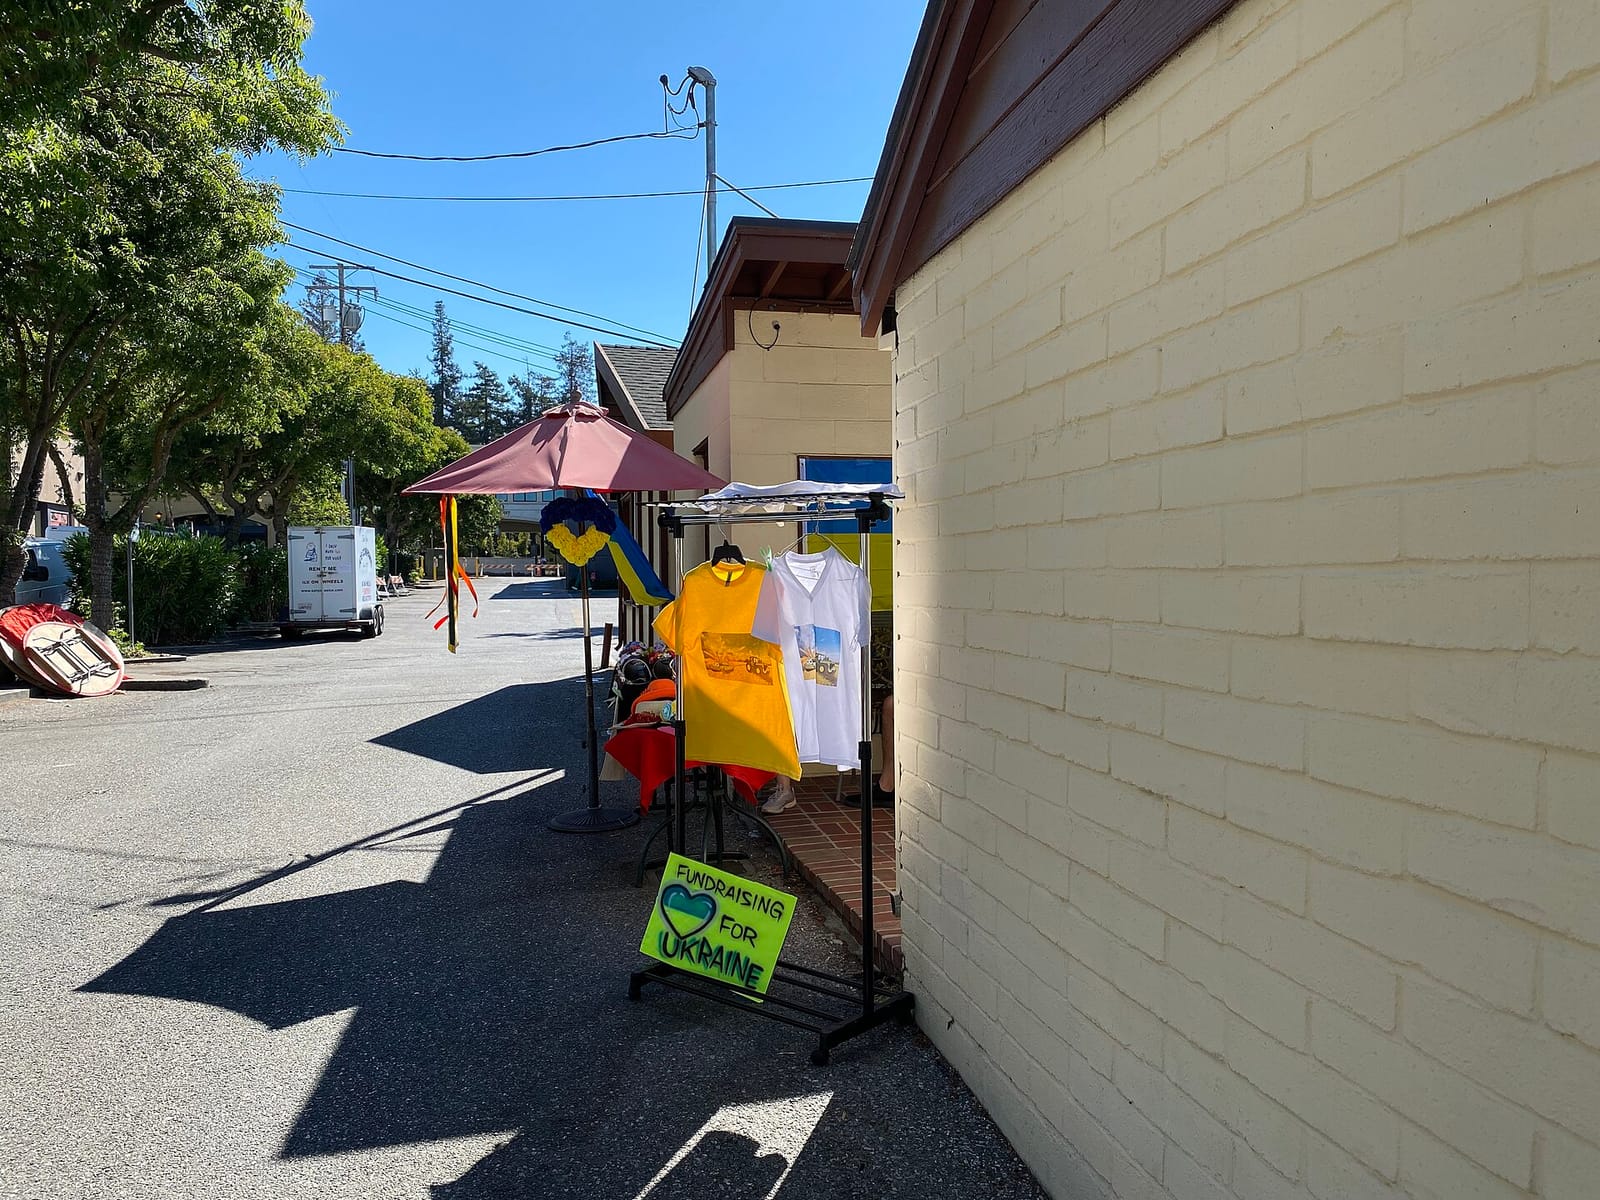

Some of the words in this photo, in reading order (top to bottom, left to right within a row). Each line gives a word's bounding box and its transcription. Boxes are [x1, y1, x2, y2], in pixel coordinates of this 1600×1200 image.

[677, 864, 785, 922] FUNDRAISING
[719, 914, 758, 948] FOR
[660, 931, 765, 990] UKRAINE
